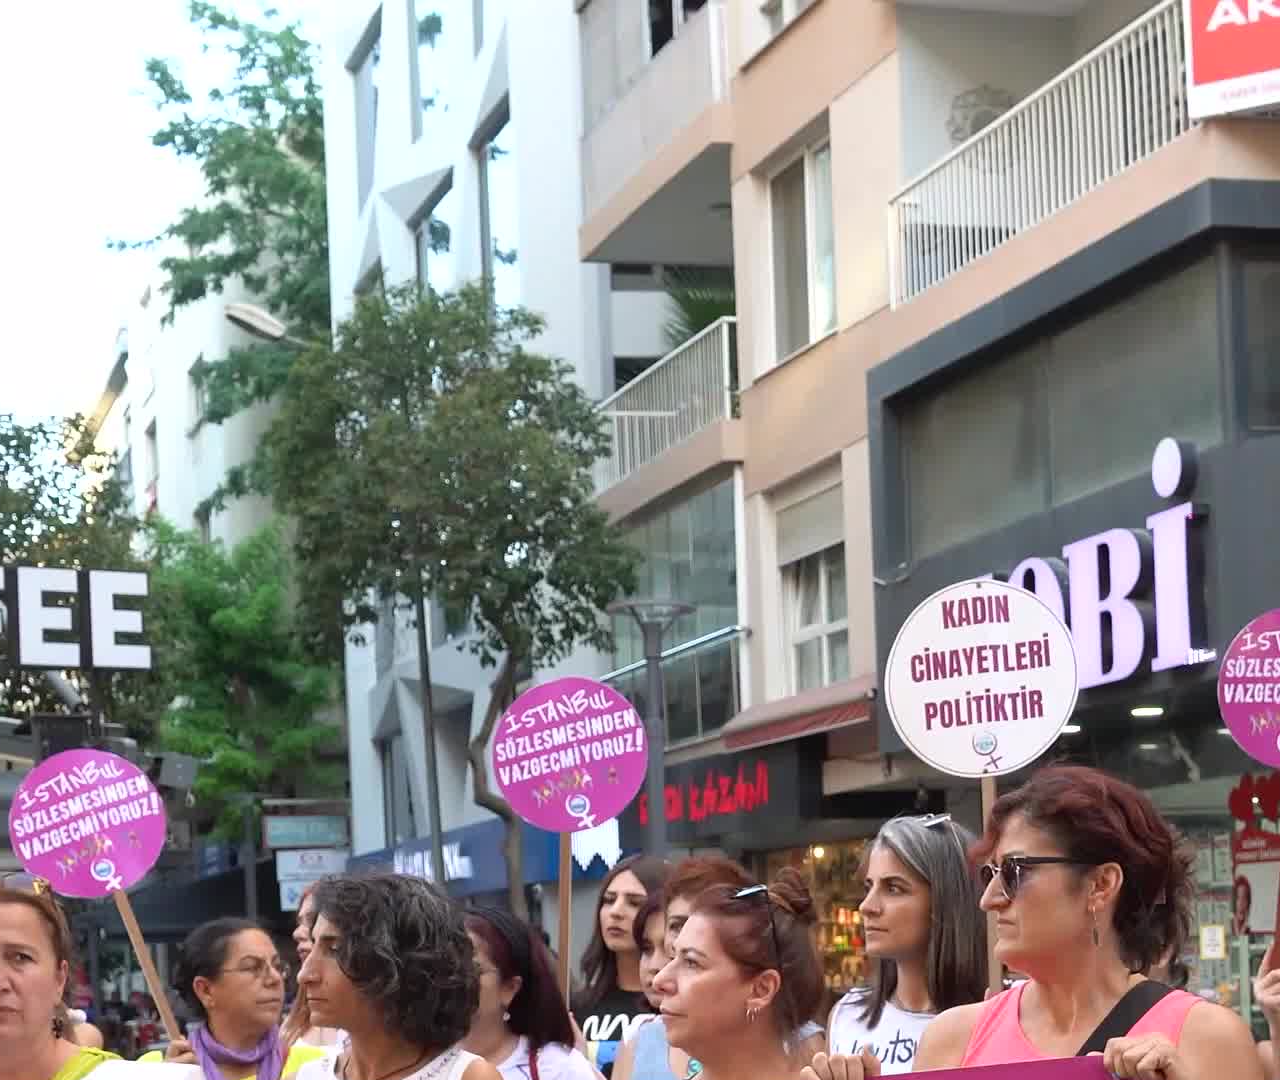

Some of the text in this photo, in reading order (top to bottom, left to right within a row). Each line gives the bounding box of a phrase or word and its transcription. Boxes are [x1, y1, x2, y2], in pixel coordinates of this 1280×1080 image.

[941, 594, 1010, 630] KADIN
[910, 632, 1052, 683] CİNAYETLERİ
[504, 689, 614, 734] İSTANBUL
[924, 685, 1045, 731] POLİTİKTİR
[497, 727, 644, 786] VAZGEÇMİYORUZ!
[18, 759, 125, 811] İSTANBUL
